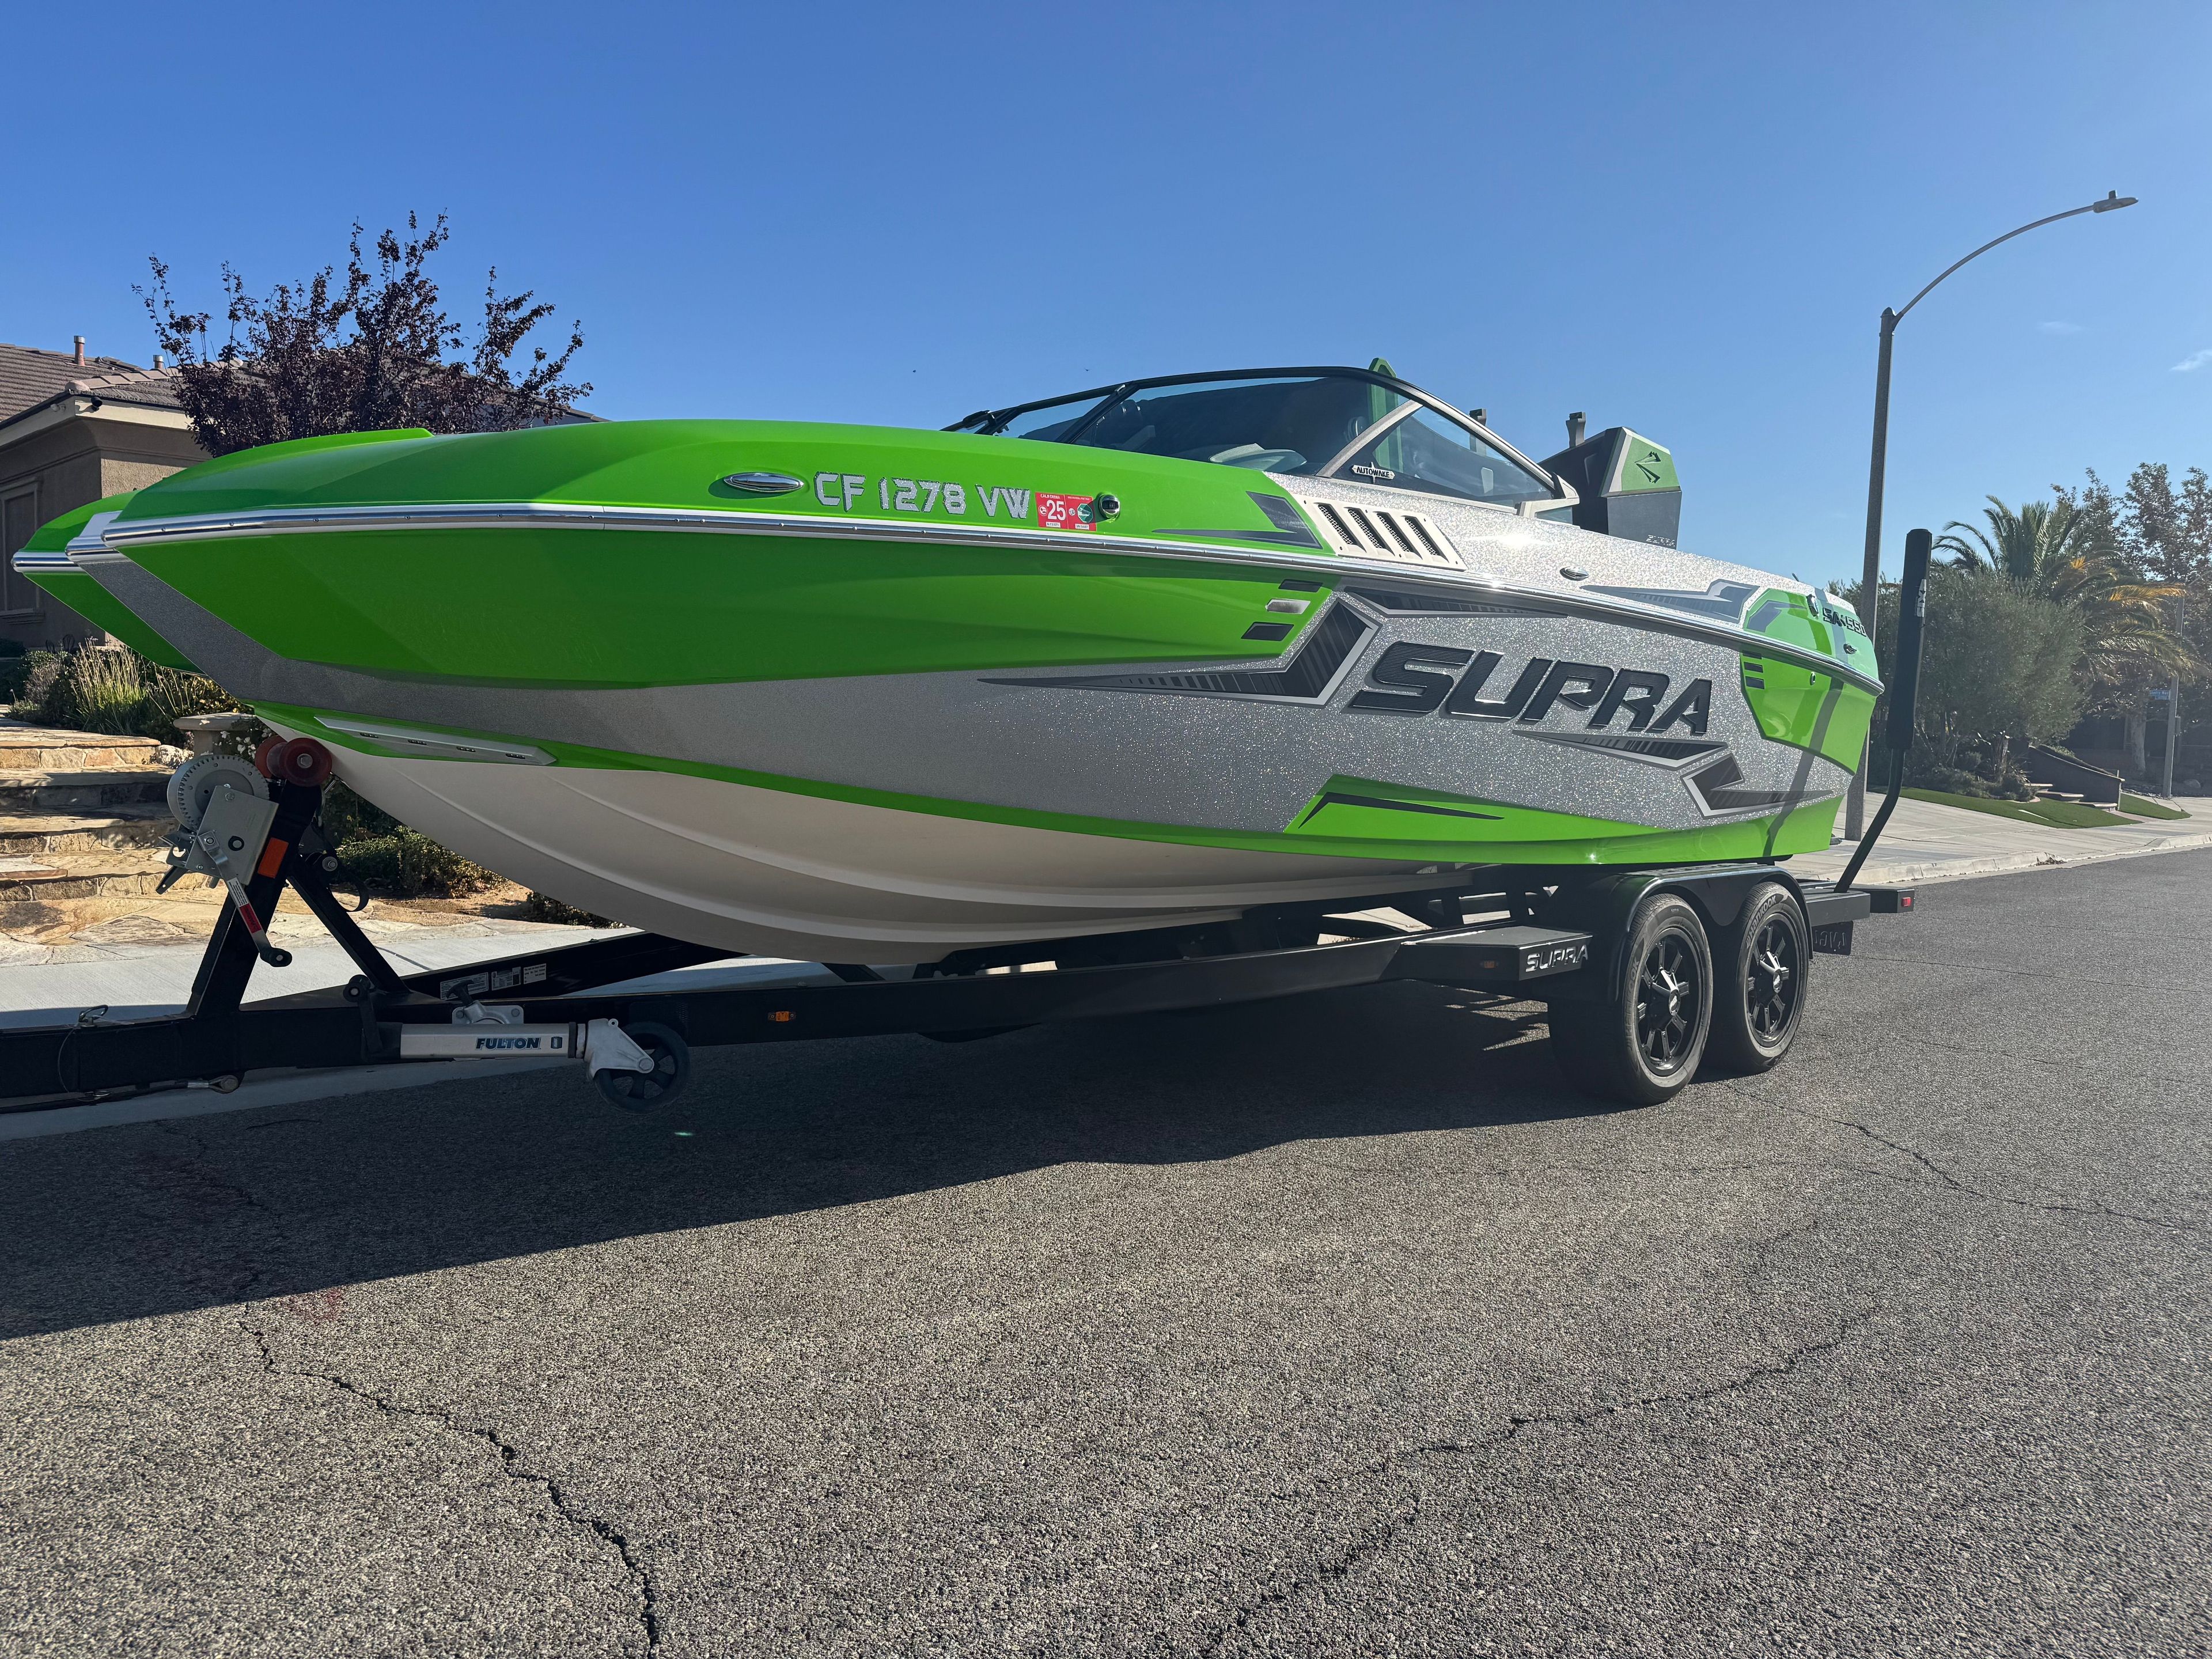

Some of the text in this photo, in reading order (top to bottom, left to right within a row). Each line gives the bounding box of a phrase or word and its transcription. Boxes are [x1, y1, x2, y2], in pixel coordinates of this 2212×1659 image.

[1356, 466, 1390, 478] AUTOWAKE
[813, 471, 1031, 519] CF 1278 VW
[1046, 499, 1066, 521] 25
[1346, 640, 1713, 736] SUPRA
[1525, 944, 1589, 973] SUPRA
[475, 1037, 541, 1051] FULTON
